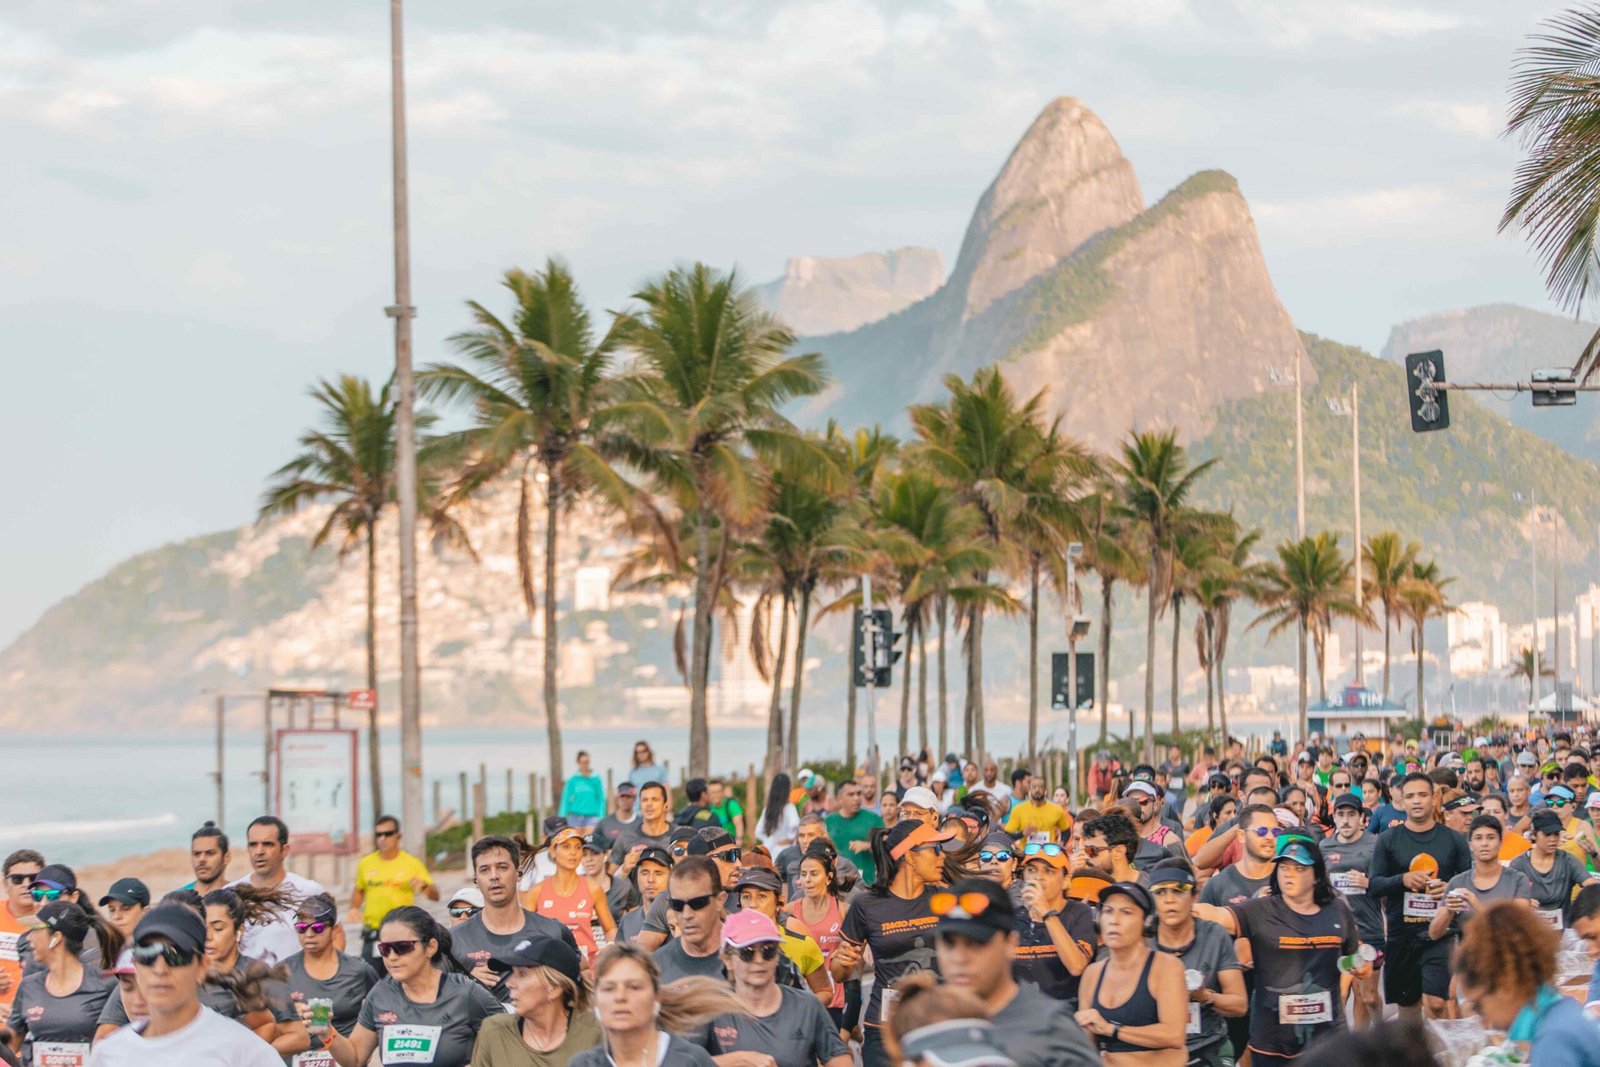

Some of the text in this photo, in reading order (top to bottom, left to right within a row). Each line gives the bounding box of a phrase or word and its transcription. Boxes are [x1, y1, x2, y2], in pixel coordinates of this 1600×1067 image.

[1359, 693, 1383, 707] TIM
[908, 916, 940, 927] PEREIR
[393, 1039, 422, 1049] 21491
